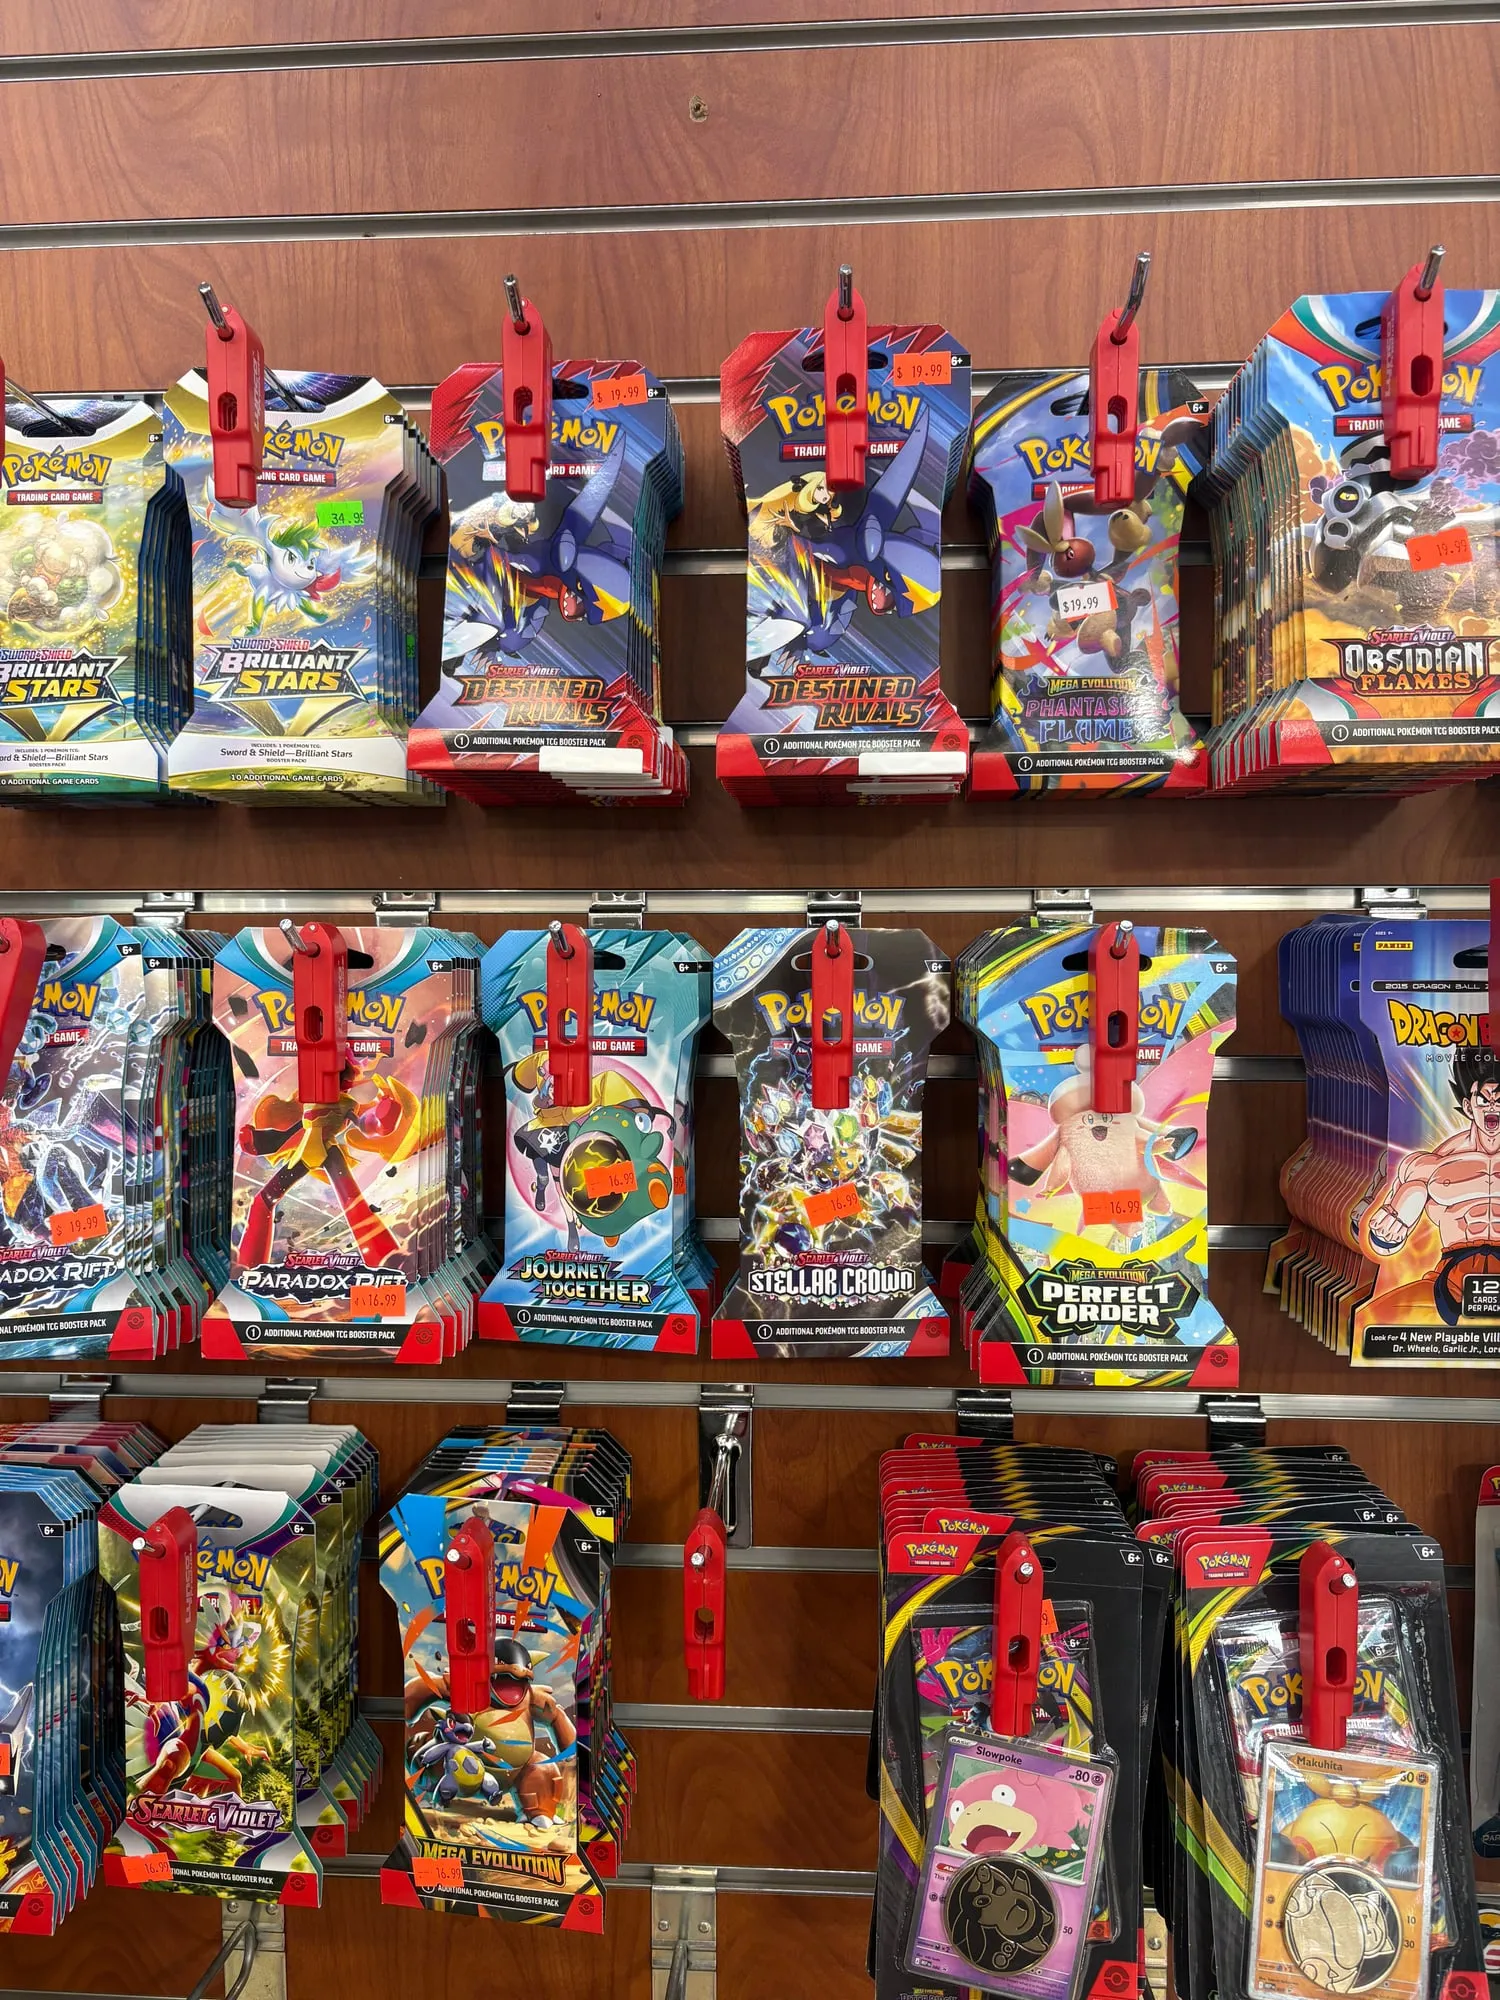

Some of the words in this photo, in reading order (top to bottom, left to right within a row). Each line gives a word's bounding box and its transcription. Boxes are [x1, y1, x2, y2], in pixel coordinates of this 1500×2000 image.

[911, 364, 942, 378] 19.99
[610, 386, 640, 401] 19.99
[1192, 403, 1203, 413] 6+
[870, 443, 899, 454] GAME
[569, 465, 596, 475] GAME
[280, 472, 300, 481] CARD
[303, 473, 326, 483] GAME
[17, 493, 49, 502] TRADING
[51, 493, 70, 502] CARD
[72, 493, 93, 501] GAME
[1436, 539, 1468, 557] 19.99
[1062, 597, 1099, 612] $19.99
[220, 652, 350, 673] BRILLIANT
[1345, 642, 1484, 679] OBSIDIAN
[234, 671, 342, 694] STARS
[1050, 678, 1078, 690] MEGA
[1361, 672, 1471, 692] FLAMES
[3, 679, 101, 702] STARS
[461, 678, 604, 704] DESTINED
[769, 677, 916, 705] DESTINED
[505, 701, 611, 726] RIVALS
[819, 702, 925, 727] RIVALS
[1352, 727, 1396, 737] ADDITIONAL
[1397, 726, 1432, 736] POKÉMON
[1433, 727, 1447, 736] TCG
[1448, 726, 1481, 735] BOOSTER
[473, 736, 508, 745] ADDITIONAL
[512, 736, 545, 746] POKÉMON
[546, 738, 558, 746] TCG
[559, 738, 589, 747] BOOSTER
[589, 738, 606, 747] PACK
[783, 741, 823, 750] ADDITIONAL
[824, 740, 857, 749] POKÉMON
[858, 740, 871, 749] TCG
[872, 740, 901, 749] BOOSTER
[903, 740, 921, 748] PACK
[220, 748, 250, 757] Sword
[250, 749, 257, 757] &
[331, 750, 353, 758] Stars
[1036, 760, 1073, 768] ADDITIONAL
[1074, 758, 1105, 768] POKÉMON
[1106, 759, 1118, 767] TCG
[1119, 758, 1146, 767] BOOSTER
[1147, 757, 1164, 766] PACK
[230, 773, 242, 781] 10
[243, 773, 291, 781] ADDITIONAL
[292, 774, 316, 782] GAME
[317, 774, 343, 782] CARDS
[122, 945, 133, 955] 6+
[149, 958, 161, 968] 6+
[432, 962, 444, 971] 6+
[678, 963, 690, 972] 6+
[931, 962, 943, 972] 6+
[1215, 963, 1228, 972] 6+
[1387, 998, 1479, 1048] DRAGON
[54, 1032, 81, 1043] GAME
[353, 1042, 381, 1052] GAME
[610, 1041, 636, 1051] GAME
[856, 1042, 883, 1053] GAME
[1426, 1054, 1466, 1062] MOVIE
[608, 1172, 635, 1187] 16.99
[830, 1193, 858, 1211] 16.99
[1109, 1200, 1140, 1214] 16.99
[69, 1216, 98, 1233] 19.99
[63, 1262, 117, 1281] RIFT
[520, 1257, 610, 1280] JOURNEY
[1071, 1269, 1096, 1280] MEGA
[1099, 1269, 1147, 1281] EVOLUTION
[240, 1271, 347, 1290] PARADOX
[751, 1268, 837, 1296] STELLAR
[842, 1268, 913, 1296] CROWN
[542, 1280, 652, 1304] TOGETHER
[1042, 1280, 1175, 1304] PERFECT
[1472, 1281, 1500, 1294] 12
[368, 1294, 397, 1307] 16.99
[1473, 1296, 1497, 1304] CARDS
[533, 1313, 569, 1323] ADDITIONAL
[569, 1315, 597, 1325] POKÉMON
[599, 1317, 610, 1326] TCG
[610, 1318, 637, 1327] BOOSTER
[637, 1320, 653, 1329] PACK
[1057, 1303, 1160, 1326] ORDER
[13, 1321, 45, 1334] POKÉMON
[46, 1321, 59, 1332] TCG
[60, 1319, 89, 1330] BOOSTER
[90, 1318, 107, 1328] PACK
[776, 1327, 814, 1336] ADDITIONAL
[815, 1326, 846, 1336] POKÉMON
[847, 1327, 859, 1335] TCG
[860, 1326, 888, 1335] BOOSTER
[888, 1326, 906, 1334] PACK
[264, 1329, 302, 1337] ADDITIONAL
[303, 1329, 335, 1338] POKÉMON
[336, 1330, 347, 1338] TCG
[348, 1330, 377, 1339] BOOSTER
[378, 1330, 395, 1339] PACK
[1400, 1332, 1407, 1342] 4
[1410, 1332, 1432, 1342] New
[1434, 1332, 1480, 1345] Playable
[1393, 1344, 1405, 1352] Dr.
[1407, 1344, 1441, 1354] Wheelo,
[1443, 1344, 1468, 1353] Garlic
[1469, 1345, 1482, 1354] Jr.,
[1047, 1351, 1088, 1361] ADDITIONAL
[1089, 1351, 1123, 1361] POKÉMON
[1124, 1353, 1138, 1361] TCG
[1139, 1353, 1169, 1362] BOOSTER
[1170, 1353, 1188, 1362] PACK
[44, 1526, 54, 1535] 6+
[294, 1525, 304, 1533] 6+
[581, 1541, 592, 1551] 6+
[1421, 1547, 1435, 1557] 6+
[976, 1746, 1022, 1766] Slowpoke
[1296, 1754, 1343, 1771] Makuhita
[1075, 1769, 1090, 1782] 80
[144, 1861, 170, 1875] 16.99
[472, 1850, 562, 1882] EVOLUTION
[192, 1869, 219, 1879] POKÉMON
[220, 1872, 231, 1880] TCG
[232, 1873, 257, 1883] BOOSTER
[258, 1876, 273, 1885] PACK
[436, 1866, 461, 1880] 16.99
[438, 1885, 473, 1896] ADDITIONAL
[474, 1888, 503, 1900] POKÉMON
[503, 1893, 515, 1901] TCG
[516, 1894, 542, 1905] BOOSTER
[543, 1898, 559, 1907] PACK
[1407, 1916, 1416, 1925] 10
[1062, 1926, 1073, 1935] 50
[1404, 1940, 1414, 1949] 30
